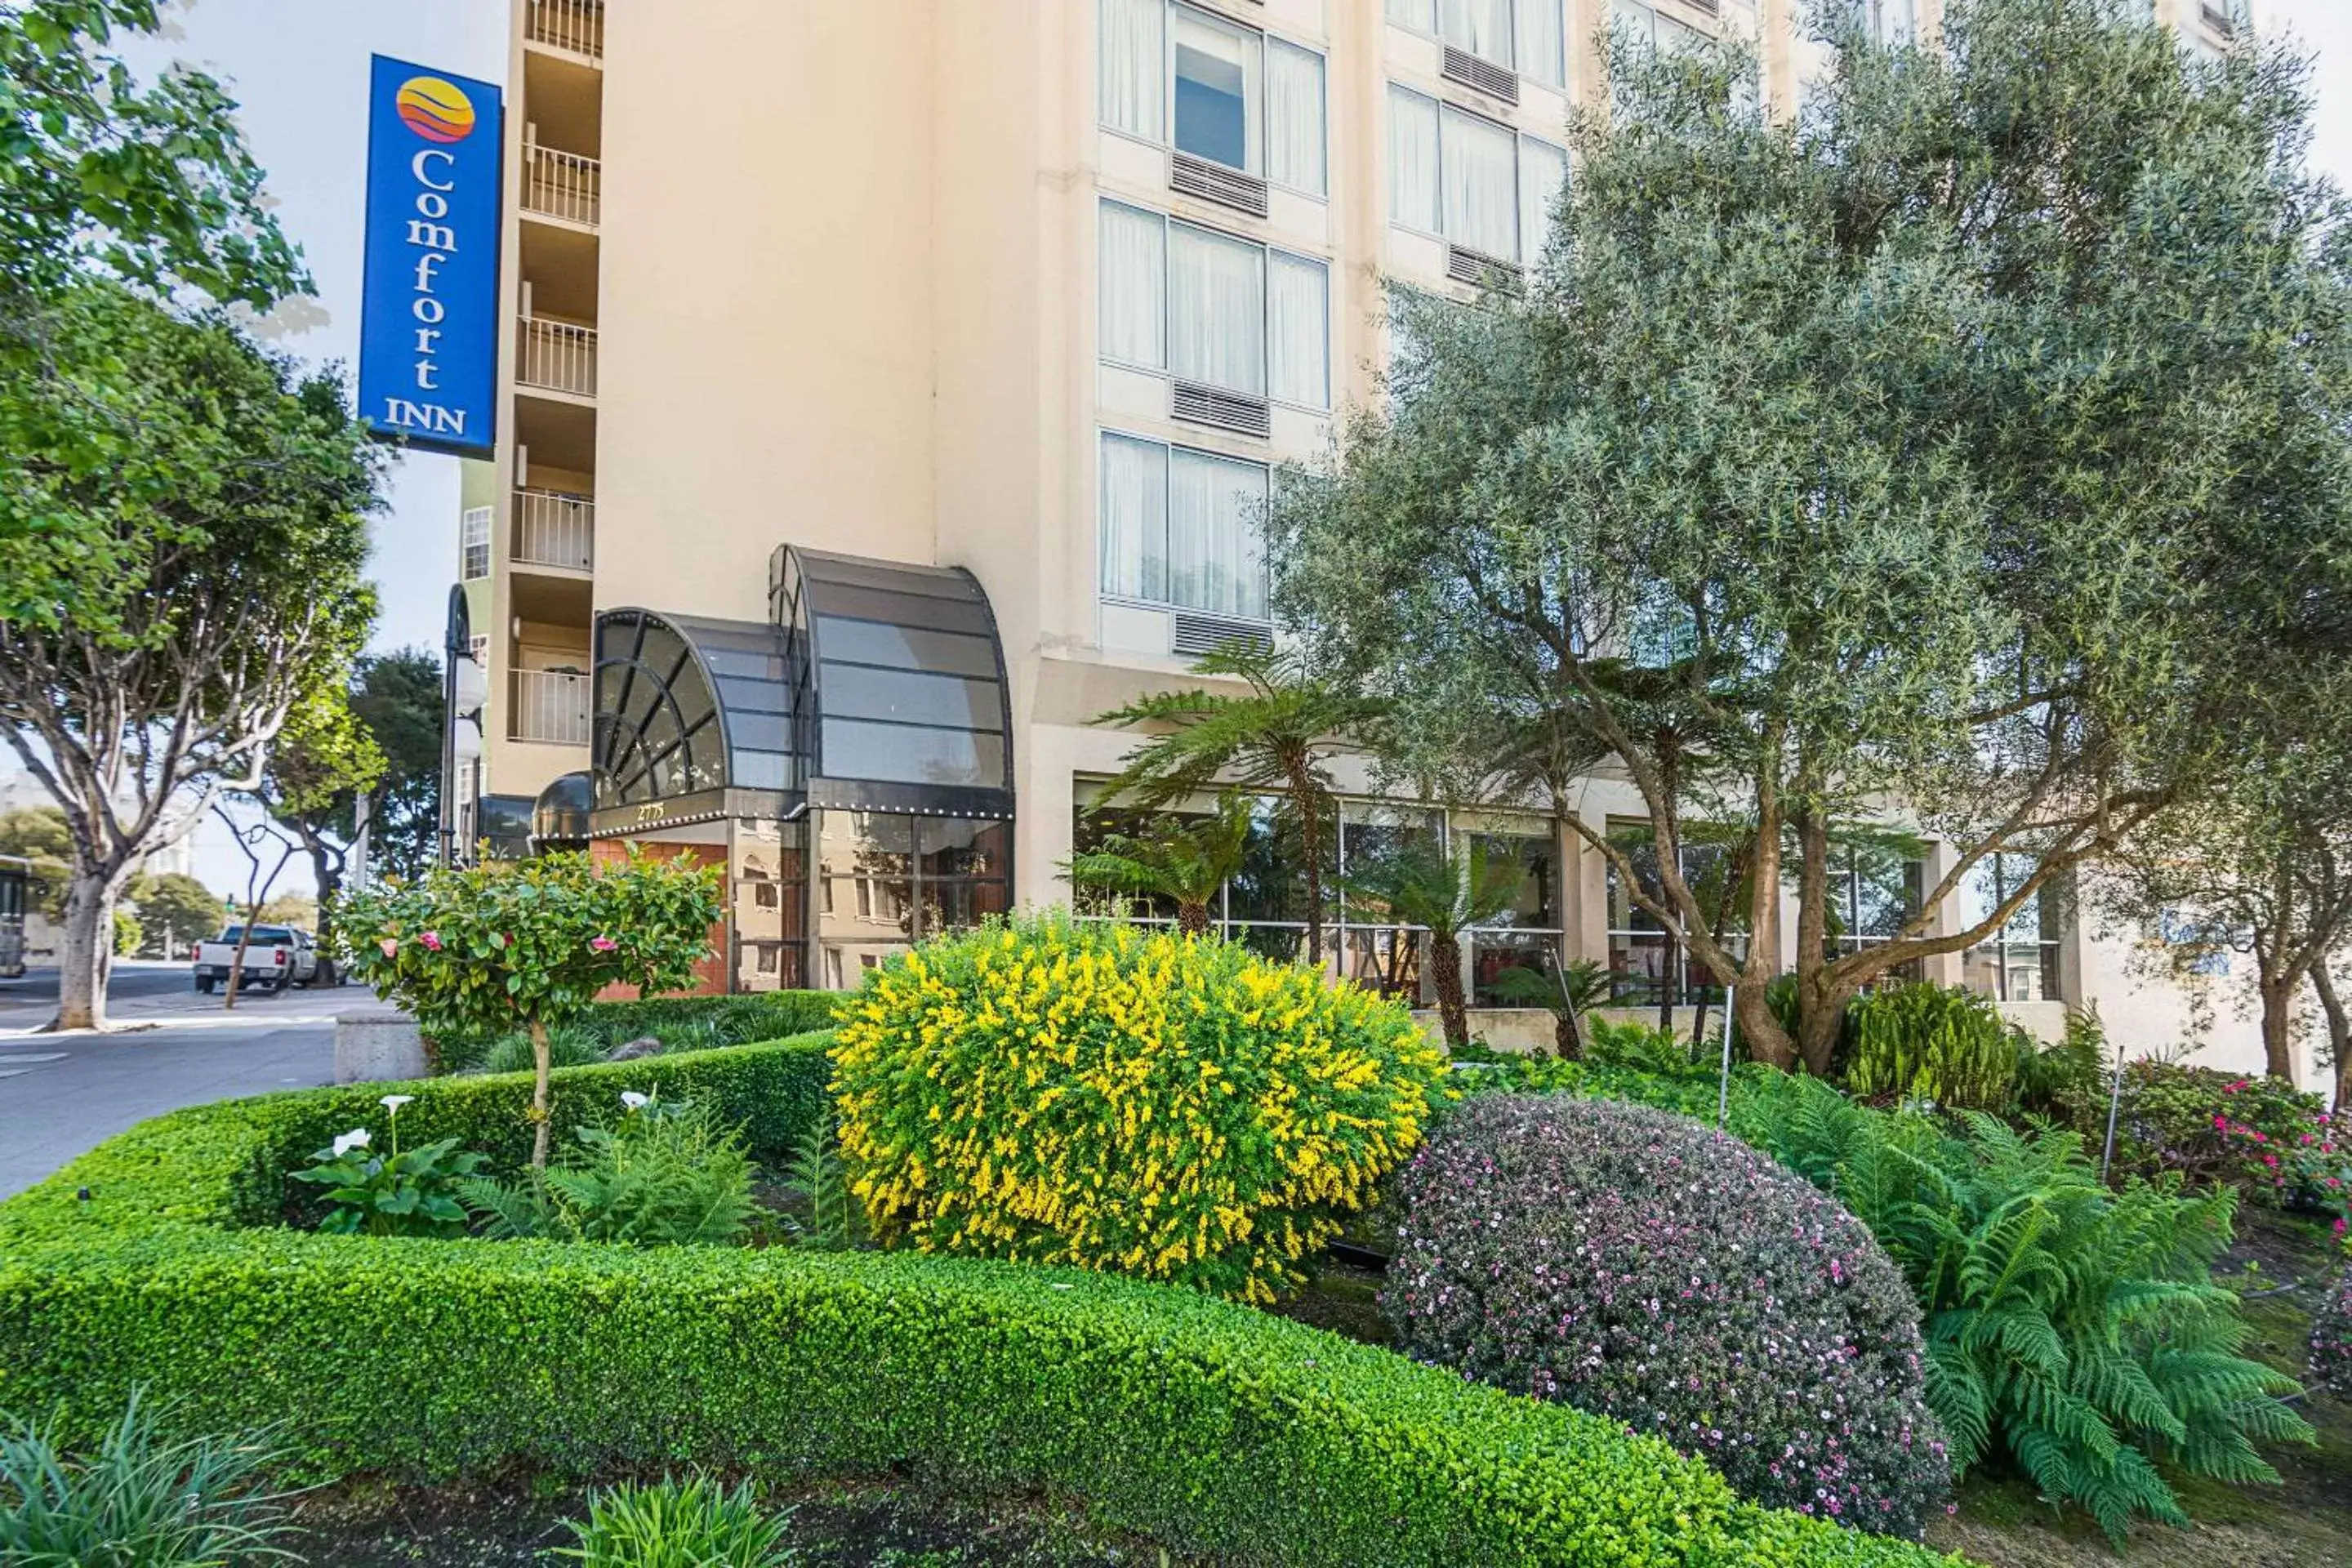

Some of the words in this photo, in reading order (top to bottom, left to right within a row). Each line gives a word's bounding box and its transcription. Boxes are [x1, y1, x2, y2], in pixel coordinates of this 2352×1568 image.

[406, 149, 458, 390] Comfort
[384, 398, 466, 435] INN
[637, 802, 664, 821] 2775
